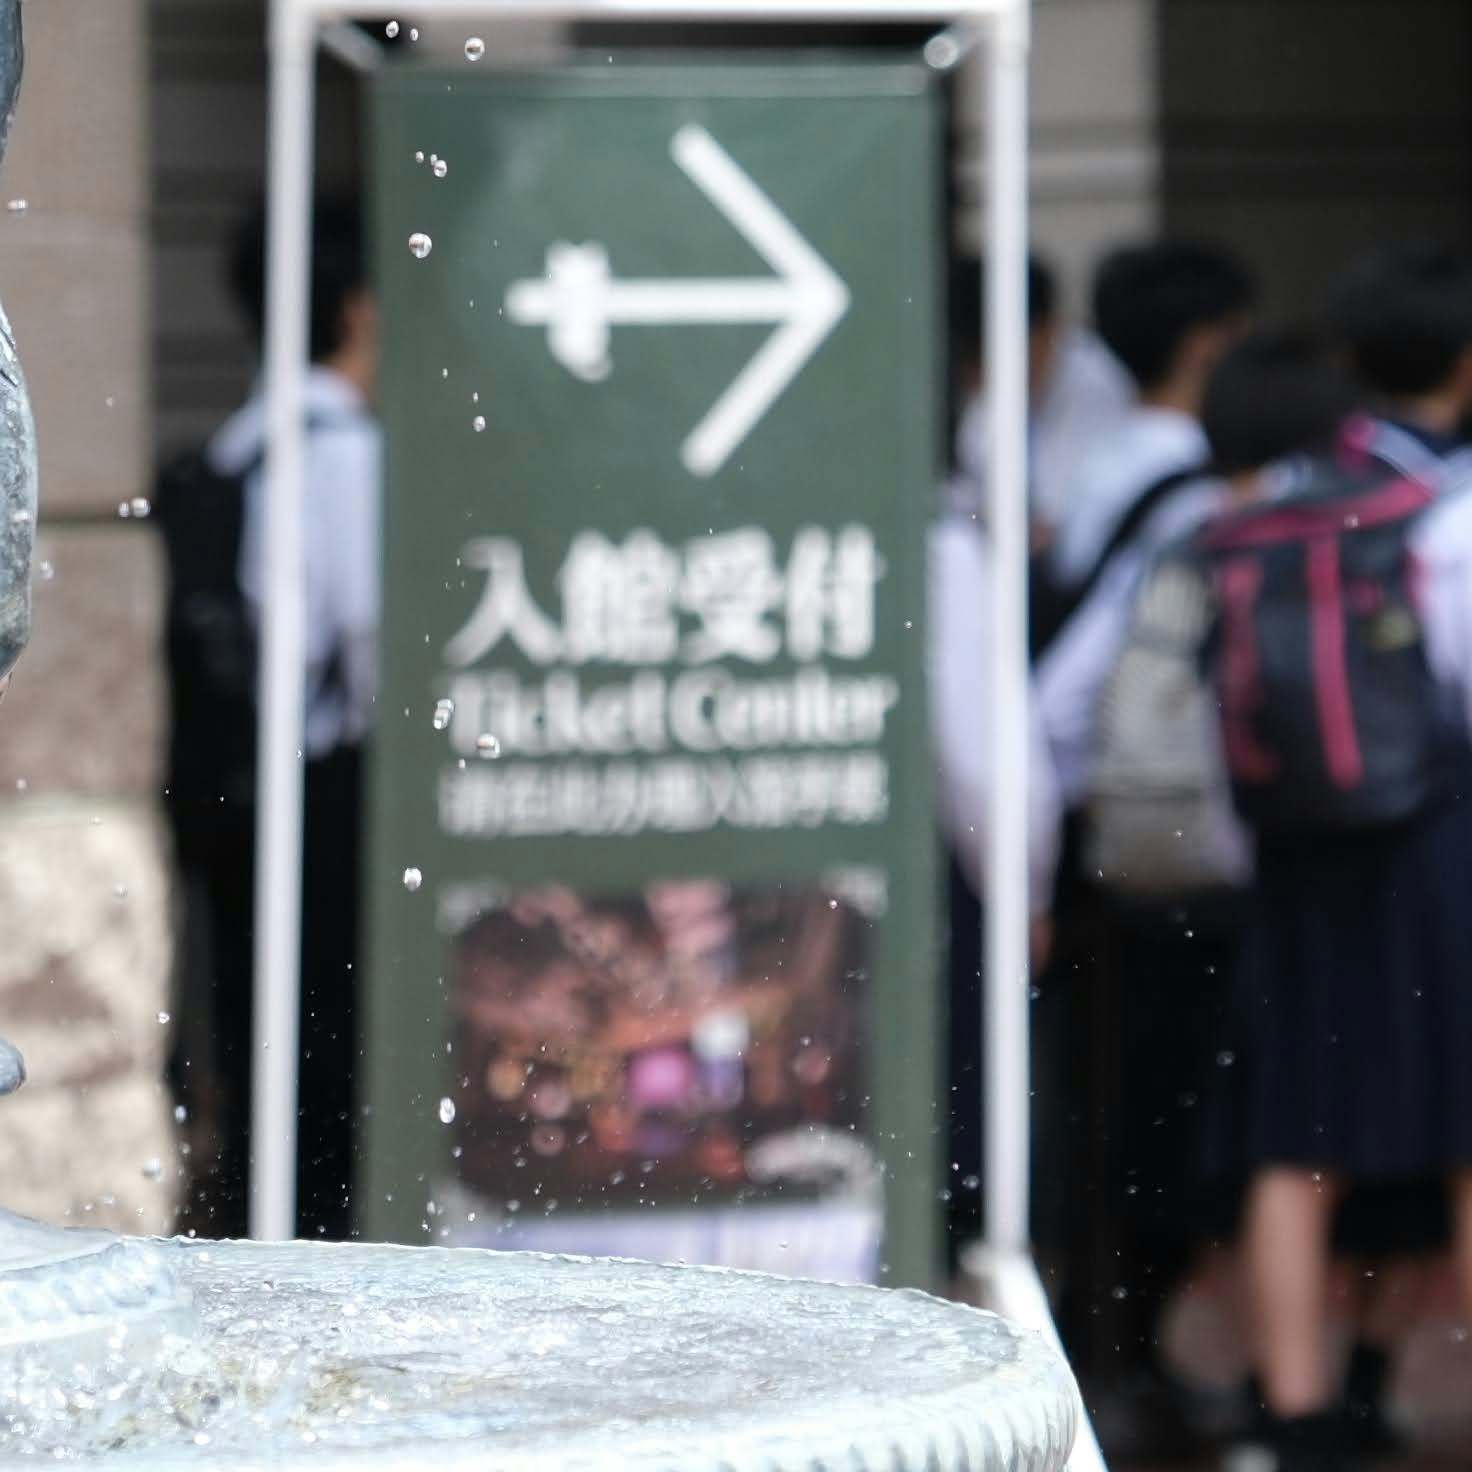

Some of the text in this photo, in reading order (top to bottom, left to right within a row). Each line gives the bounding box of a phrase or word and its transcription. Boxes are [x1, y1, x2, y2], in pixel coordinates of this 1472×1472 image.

[443, 527, 882, 666] 入館受付
[444, 667, 897, 754] Ticket Center
